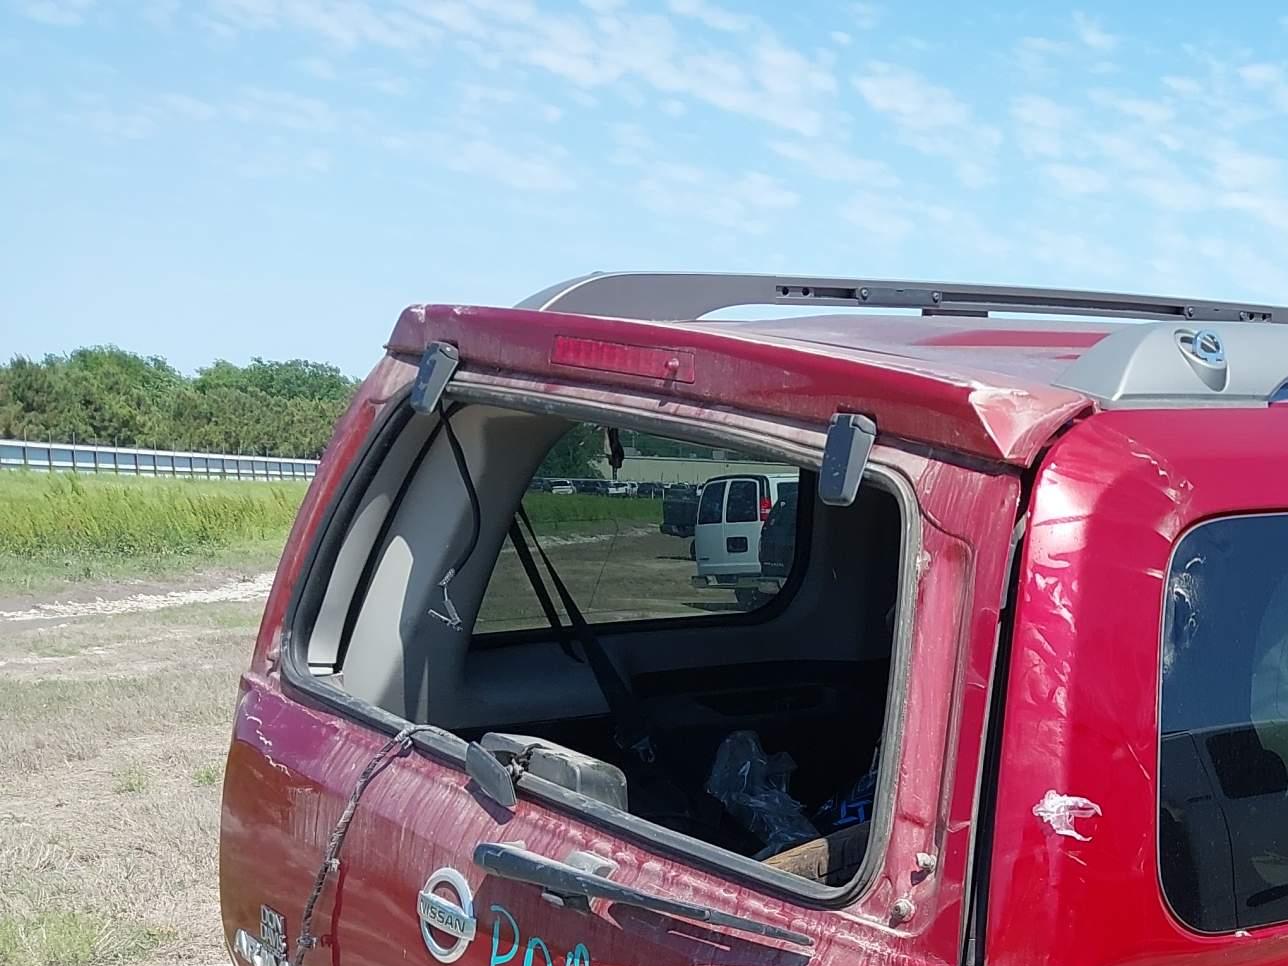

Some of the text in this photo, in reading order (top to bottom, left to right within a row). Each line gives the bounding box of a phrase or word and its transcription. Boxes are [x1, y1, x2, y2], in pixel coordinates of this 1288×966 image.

[260, 904, 286, 936] DON
[419, 902, 466, 934] NISSAN
[260, 922, 287, 956] DAVIS
